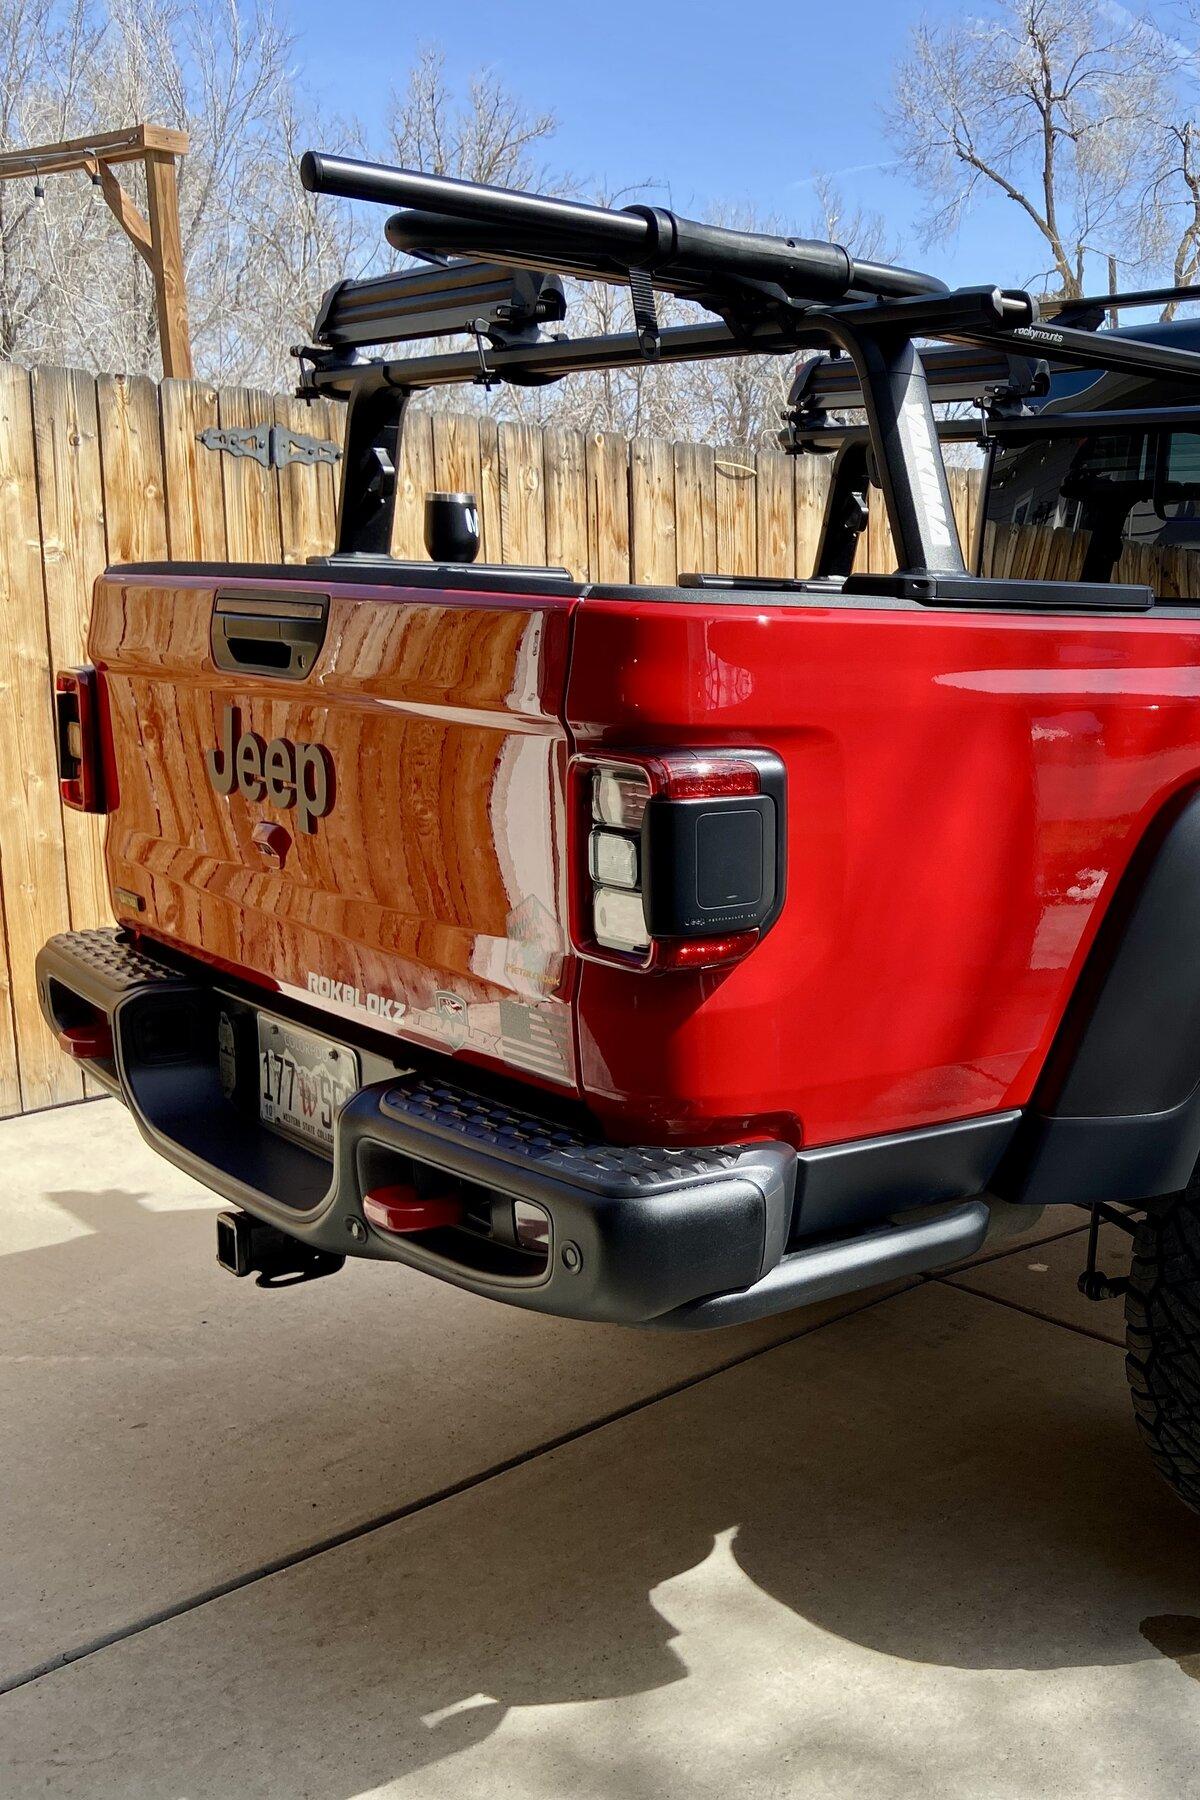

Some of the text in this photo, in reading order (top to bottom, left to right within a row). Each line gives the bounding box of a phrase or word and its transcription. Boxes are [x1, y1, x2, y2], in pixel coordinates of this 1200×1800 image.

[1013, 326, 1064, 342] rockymounts
[904, 402, 951, 546] YAKIMA
[207, 706, 336, 835] Jeep
[307, 971, 406, 1025] ROKBLOKZ
[302, 1121, 315, 1137] STATE
